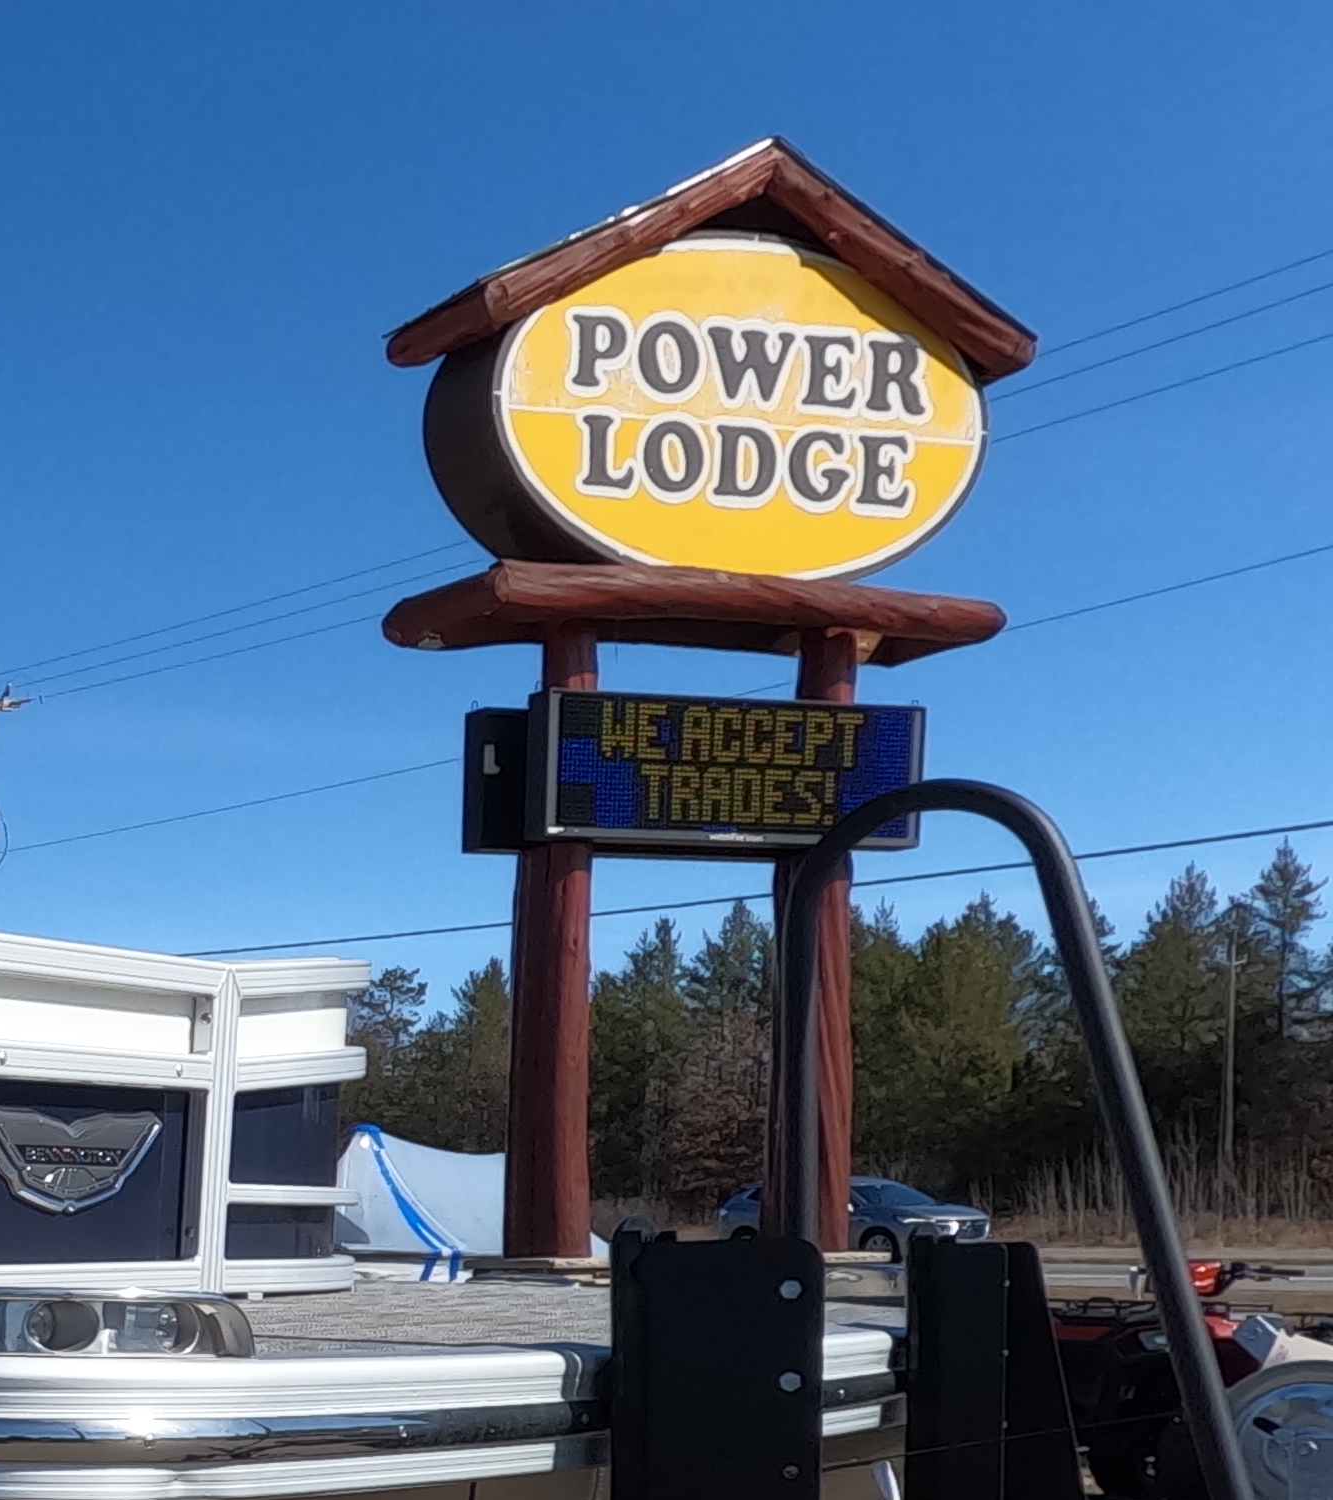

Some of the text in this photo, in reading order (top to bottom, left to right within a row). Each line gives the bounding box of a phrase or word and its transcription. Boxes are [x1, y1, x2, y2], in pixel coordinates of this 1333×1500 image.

[569, 311, 928, 418] POWER
[579, 412, 912, 511] LODGE
[600, 700, 865, 767] WE ACCEPT
[640, 763, 835, 826] TRADES!
